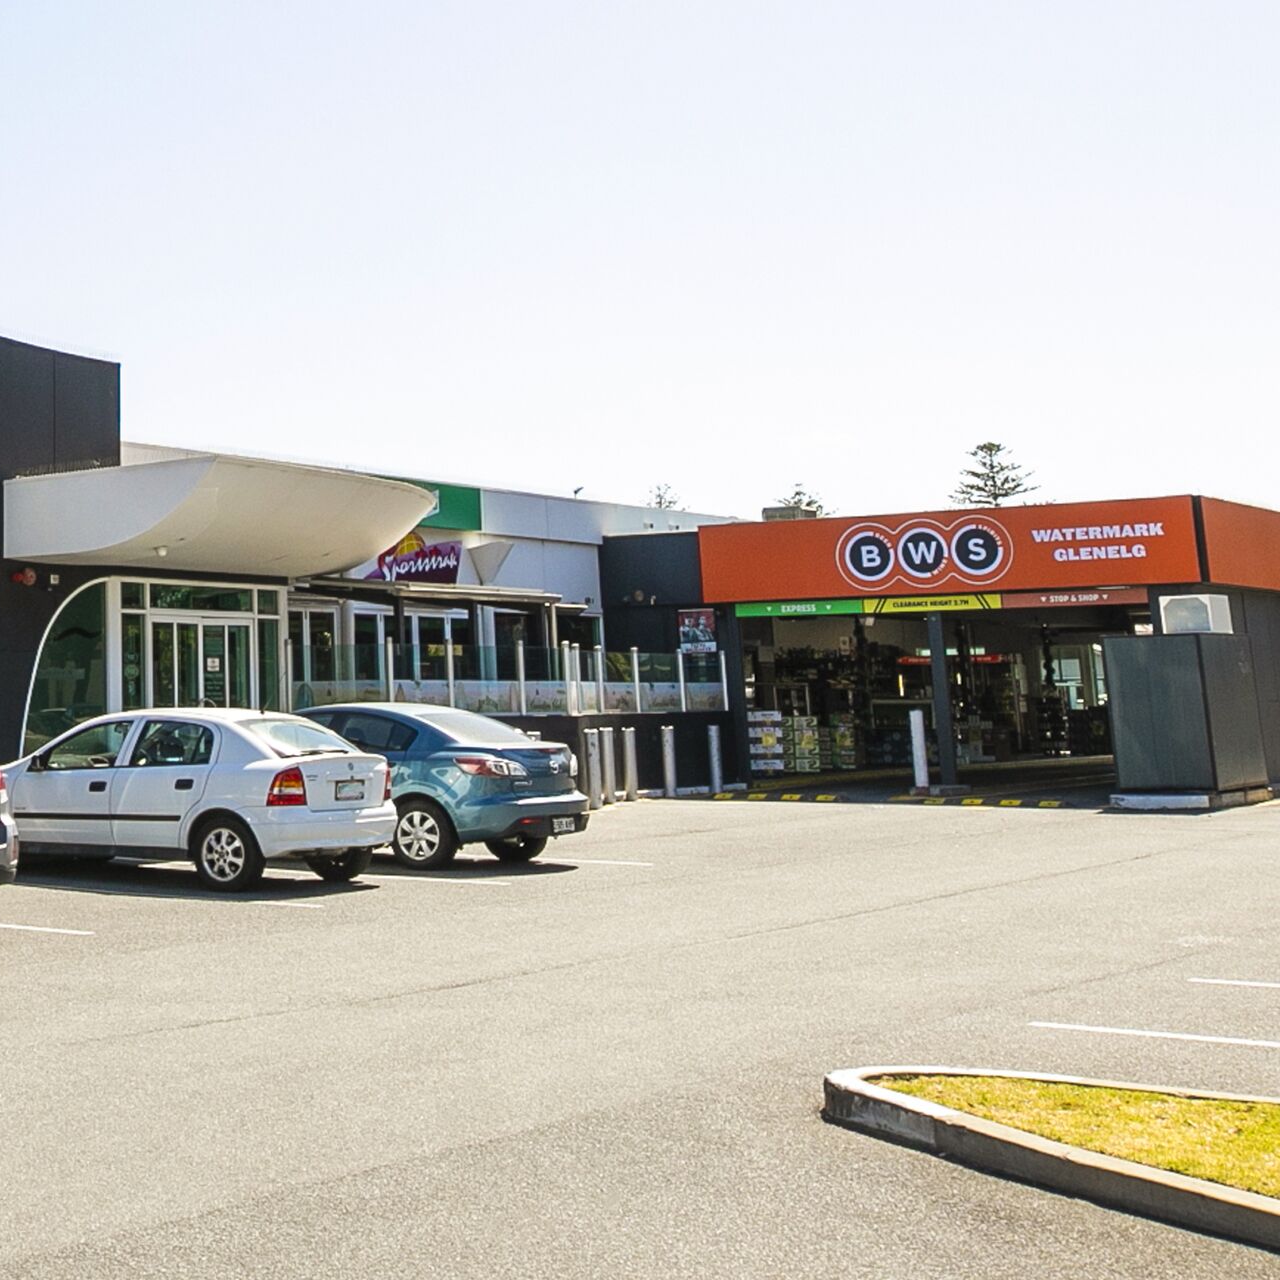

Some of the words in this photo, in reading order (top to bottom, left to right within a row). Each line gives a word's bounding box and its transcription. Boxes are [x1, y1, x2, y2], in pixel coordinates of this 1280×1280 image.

[1031, 523, 1165, 543] WATERMARK
[1053, 544, 1147, 562] GLENELG
[1049, 595, 1070, 603] STOP
[1078, 593, 1100, 602] SHOP
[780, 604, 817, 613] EXPRESS
